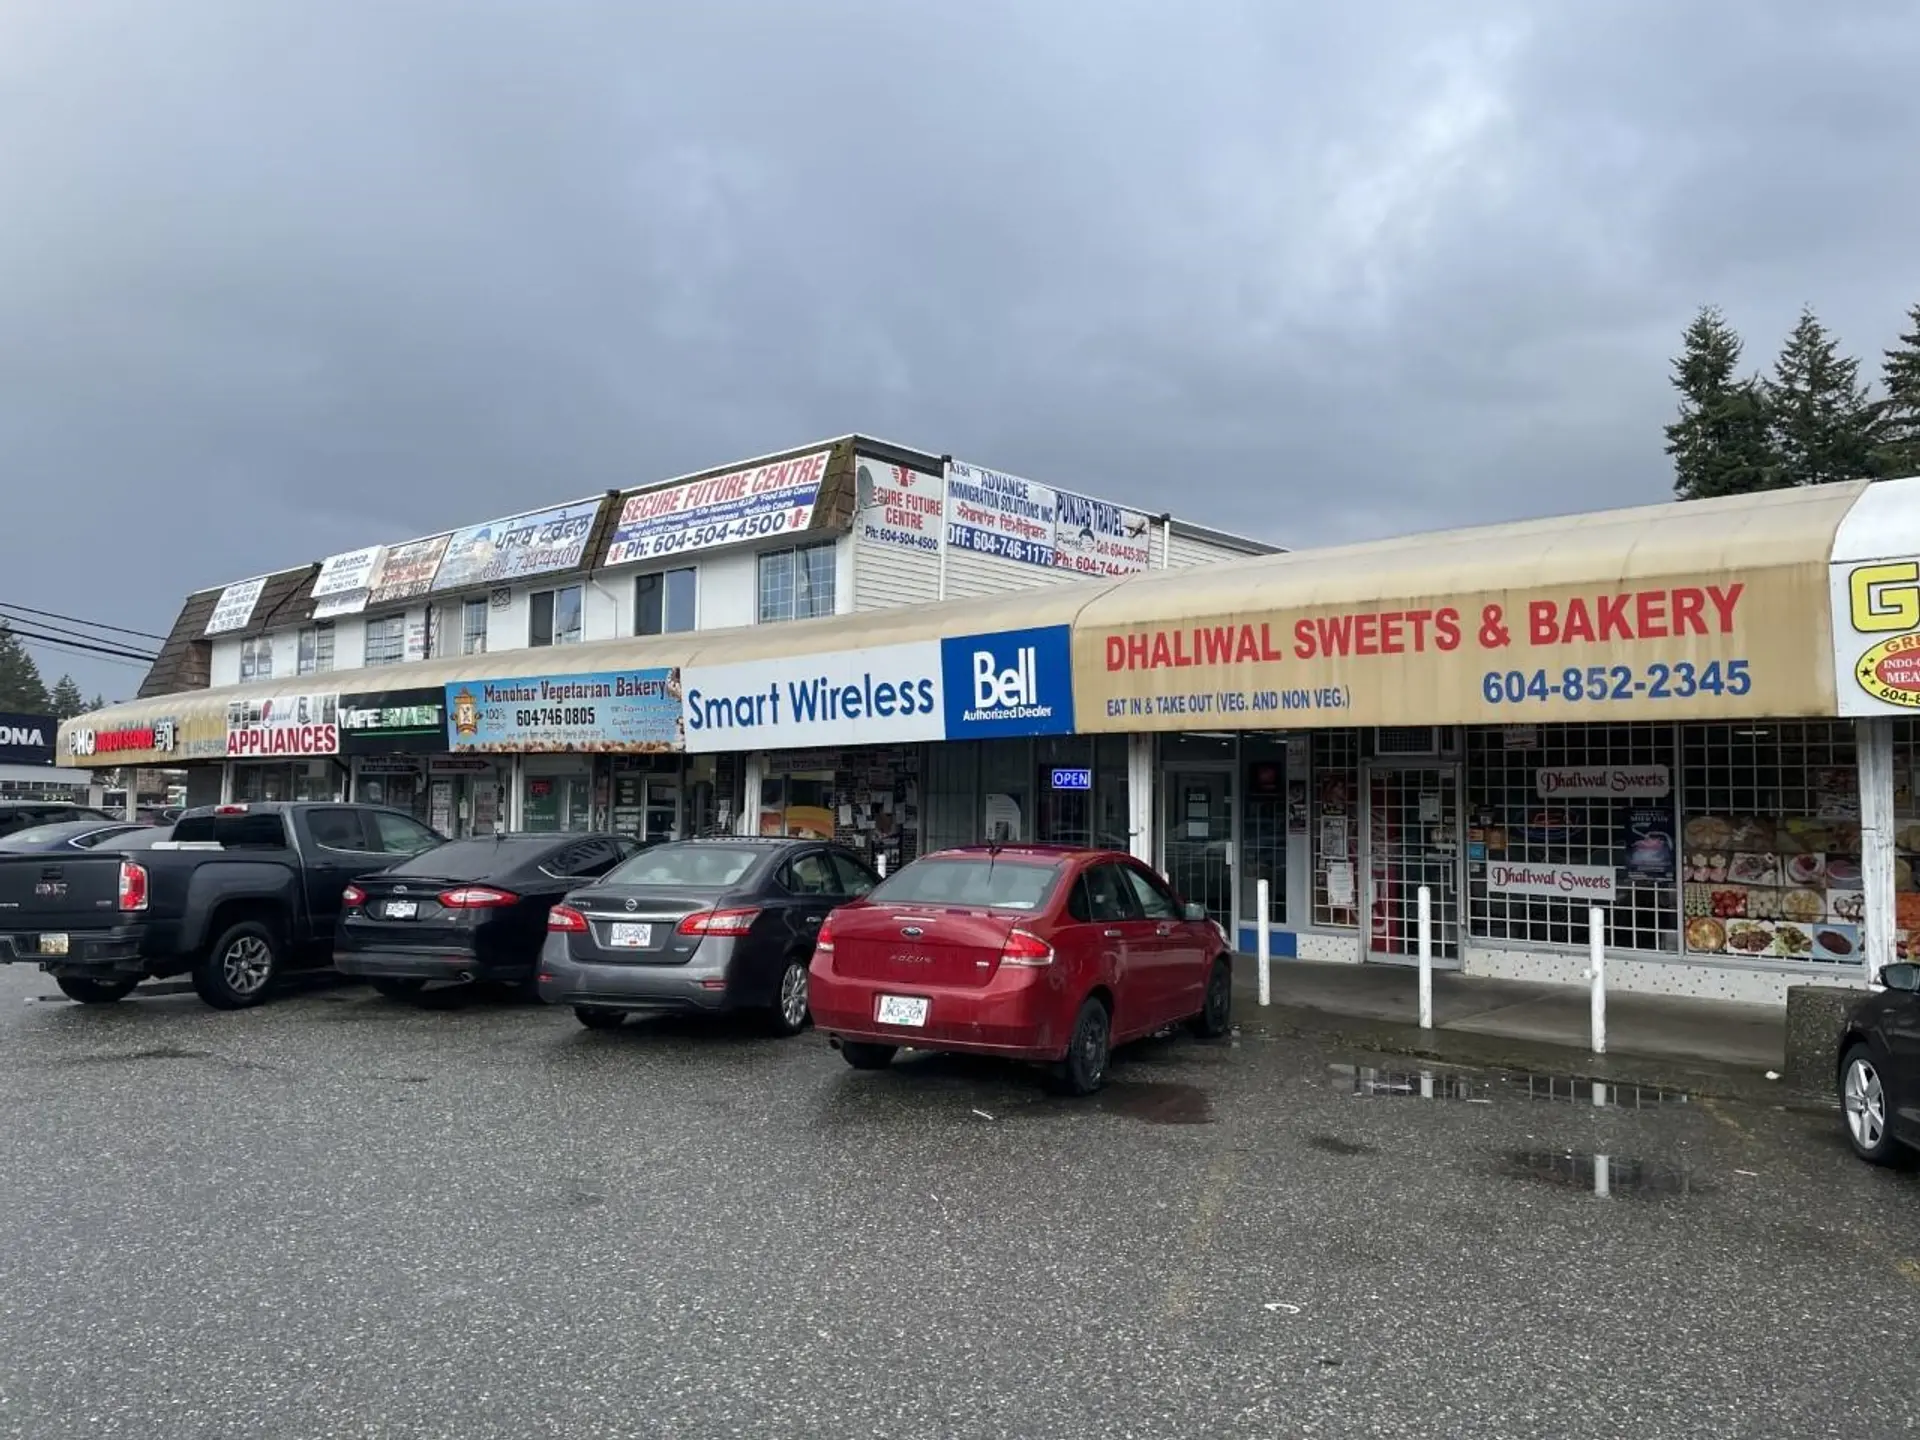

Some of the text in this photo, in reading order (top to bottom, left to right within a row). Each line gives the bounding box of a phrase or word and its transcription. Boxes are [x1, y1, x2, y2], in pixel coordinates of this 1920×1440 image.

[621, 455, 825, 522] SECURE FUTURE CENTRE
[981, 472, 1029, 499] ADVANCE
[886, 507, 923, 530] CENTRE
[906, 494, 942, 516] FUTURE
[1000, 495, 1039, 519] SOLUTIONS
[1057, 494, 1124, 537] PUNJAB TRAVEL
[624, 541, 648, 559] Ph:
[654, 512, 786, 553] 604-504-4500
[865, 525, 938, 550] Ph: 604-504-4500
[973, 532, 1054, 566] 604-746-1175
[1055, 551, 1072, 568] Ph:
[1106, 583, 1745, 671] DHALIWAL SWEETS & BAKERY
[484, 676, 666, 704] Manohar Vegetarian Bakery
[973, 647, 1036, 708] Bell
[1483, 660, 1751, 704] 604-852-2345
[689, 672, 934, 729] Smart Wireless
[963, 705, 1052, 721] Authorized Dealer
[1107, 685, 1350, 717] EAT IN & TAKE OUT (VEG. AND NON VEG.)
[339, 707, 381, 729] VAPE
[69, 728, 95, 755] PHO
[228, 725, 336, 754] APPLIANCES
[1054, 772, 1087, 785] OPEN
[1541, 771, 1665, 792] Dhaliwal Sweets
[1492, 866, 1556, 886] Dhaliwal
[1558, 871, 1611, 891] Sweets
